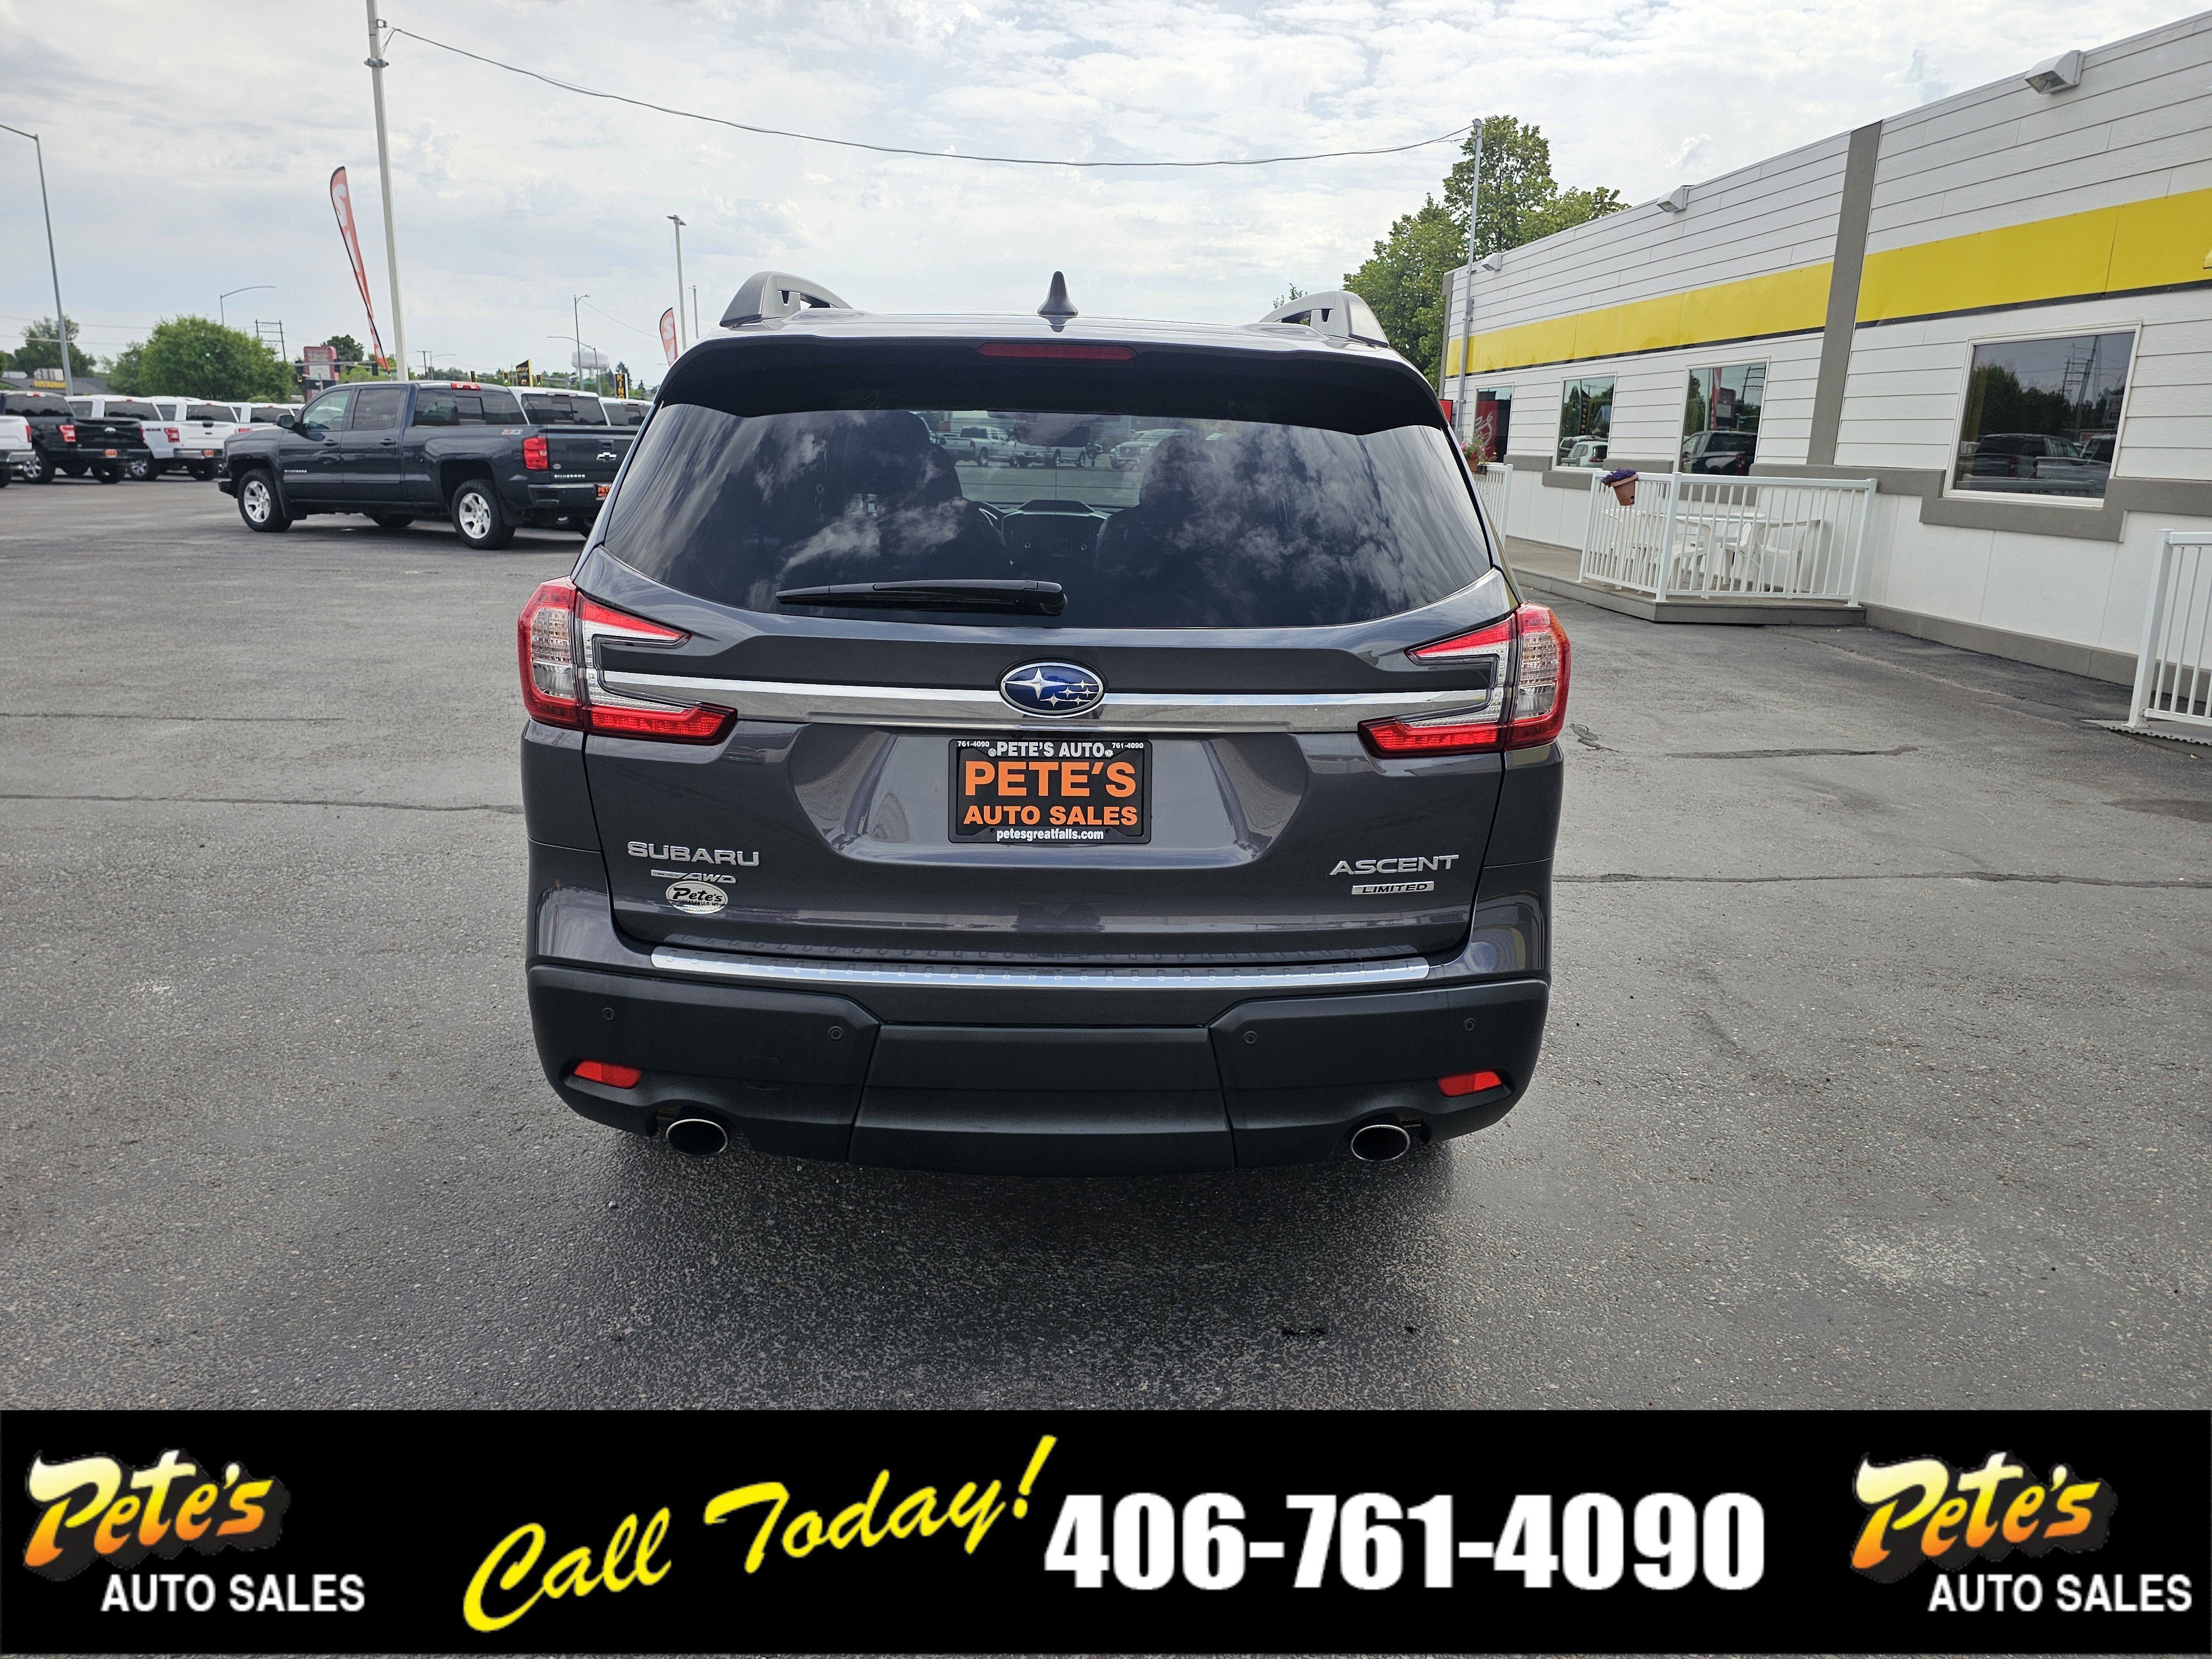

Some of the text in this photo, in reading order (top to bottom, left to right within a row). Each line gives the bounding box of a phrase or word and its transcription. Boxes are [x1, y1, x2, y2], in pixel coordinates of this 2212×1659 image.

[997, 741, 1105, 758] PETE'S AUTO
[965, 760, 1136, 797] PETE'S
[964, 805, 1138, 826] AUTO SALES
[996, 828, 1104, 842] petesgreatfalls.com
[627, 841, 759, 867] SUBARU
[1329, 854, 1459, 875] ASCENT
[682, 873, 736, 884] AWD
[672, 887, 723, 902] Pete's
[1362, 883, 1428, 894] LIMITED
